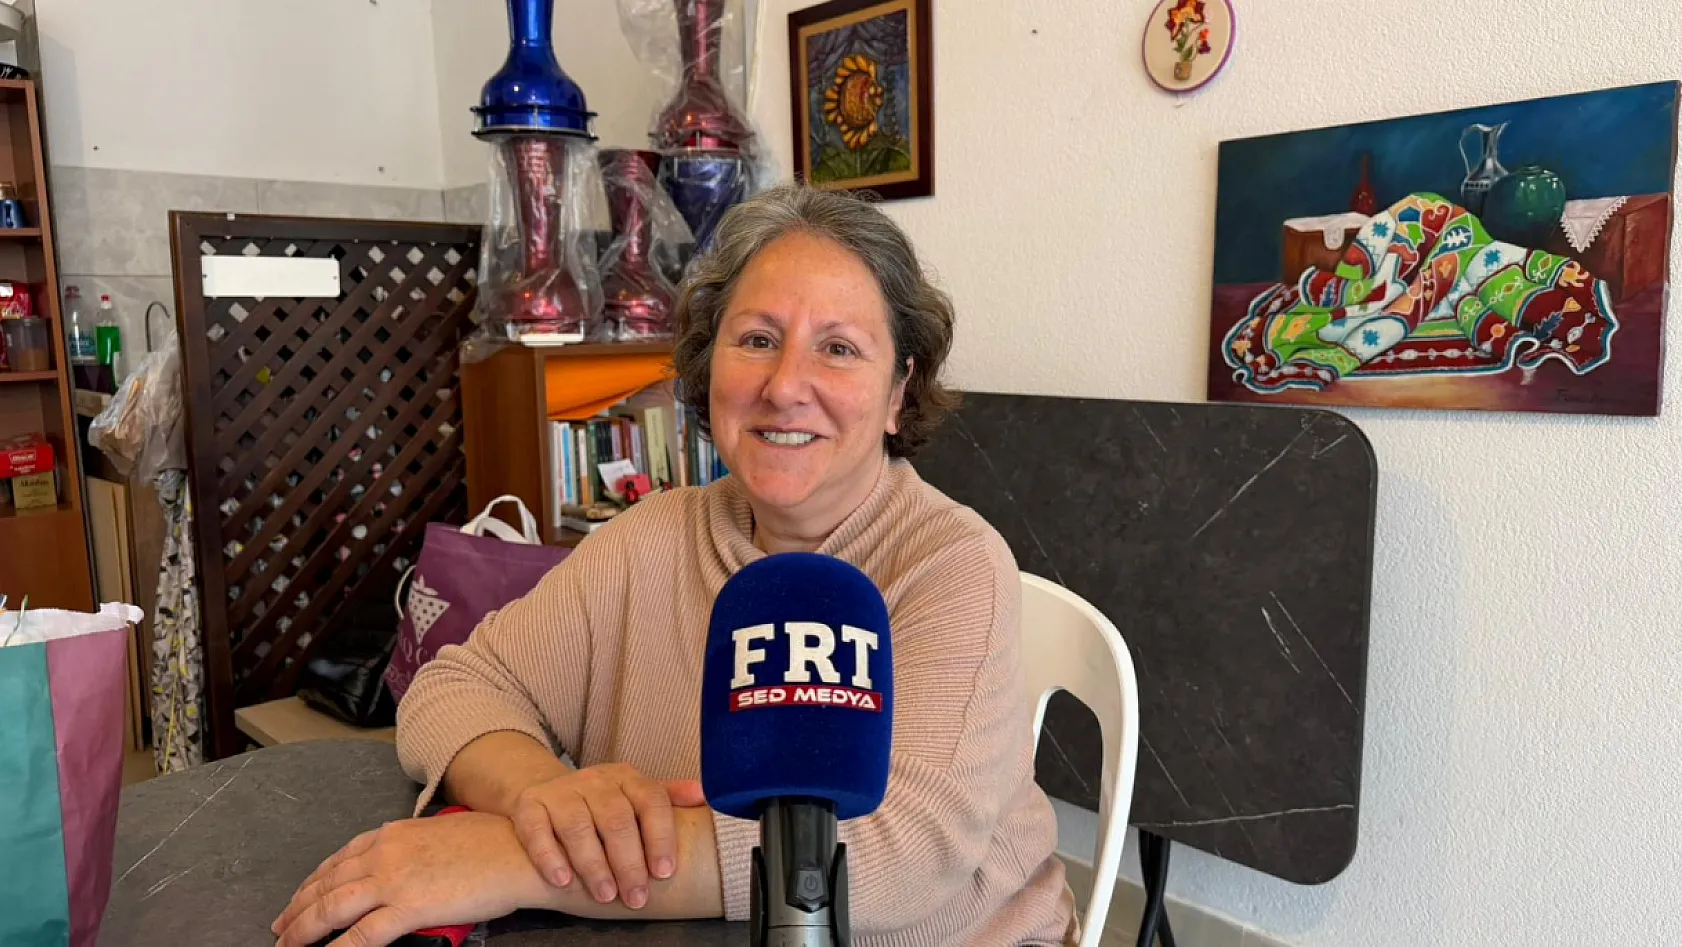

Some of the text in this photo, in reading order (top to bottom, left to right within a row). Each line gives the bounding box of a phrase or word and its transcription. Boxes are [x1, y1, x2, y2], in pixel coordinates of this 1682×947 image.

[730, 621, 878, 690] FRT
[738, 688, 876, 709] SED MEDYA
